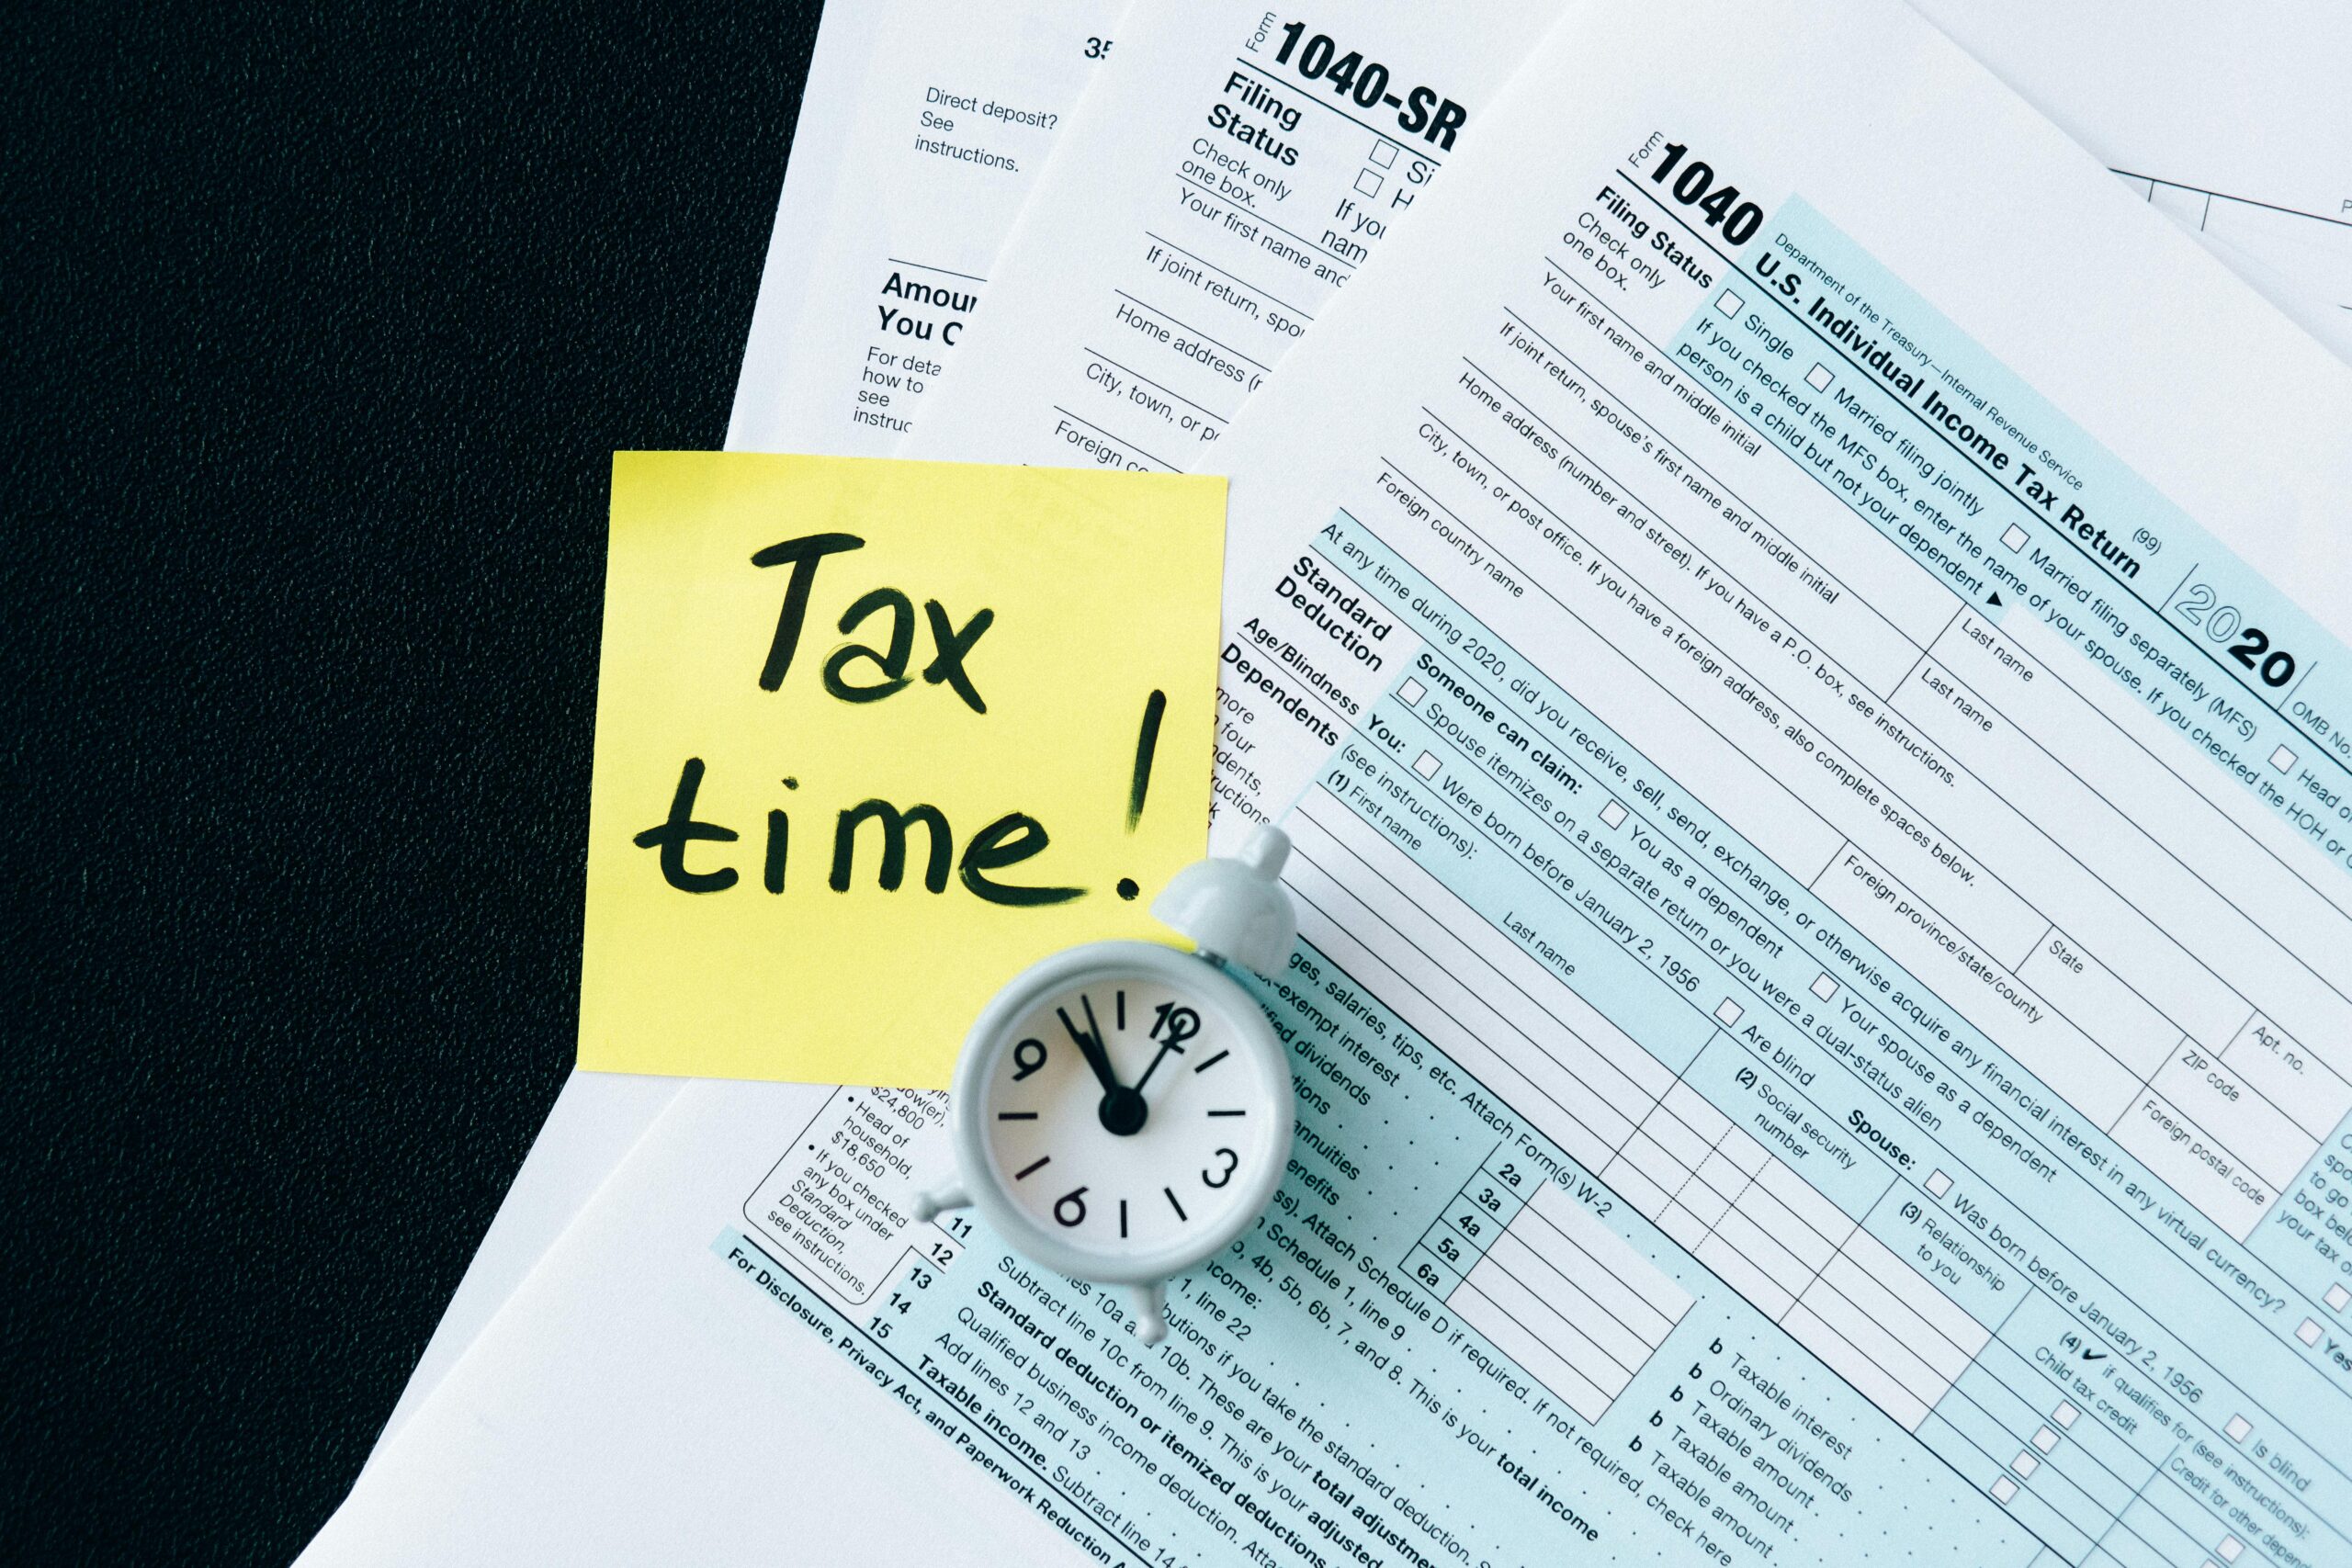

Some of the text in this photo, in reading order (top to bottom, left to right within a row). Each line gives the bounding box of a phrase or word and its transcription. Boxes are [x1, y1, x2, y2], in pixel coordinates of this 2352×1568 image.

[1245, 11, 1277, 53] Form
[925, 86, 1058, 130] Direct deposit?
[1223, 70, 1303, 132] Filing
[1275, 21, 1467, 152] 1040-SR
[921, 110, 955, 132] See
[1207, 103, 1299, 166] Status
[1627, 130, 1664, 169] Form
[914, 134, 1019, 173] instructions.
[1182, 160, 1255, 206] one box.
[1193, 138, 1293, 202] Check only
[1650, 142, 1764, 246] 1040
[1181, 186, 1311, 269] Your first name
[1577, 211, 1666, 289] Check only
[1595, 185, 1713, 288] Filing Status
[1146, 245, 1260, 321] If joint return,
[1563, 231, 1628, 291] one box.
[877, 305, 933, 341] You
[1115, 303, 1246, 383] Home address
[1744, 314, 1794, 360] Single
[862, 366, 924, 394] how to
[866, 345, 899, 367] For
[1543, 271, 1762, 457] Your first name and middle initial
[1774, 232, 1846, 296] Department
[1844, 292, 1862, 307] of
[1859, 302, 1880, 323] the
[1985, 406, 2038, 454] Revenue
[2038, 449, 2083, 491] Service
[857, 389, 890, 408] see
[1086, 363, 1202, 432] City, town, or
[1756, 251, 2141, 580] U.S. Individual Income Tax Return
[1055, 420, 1123, 468] Foreign
[1834, 387, 1984, 517] Married filing jointly
[1376, 471, 1524, 598] Foreign country name
[2132, 527, 2162, 557] (99)
[752, 533, 994, 714] Tax
[1274, 575, 1383, 672] Deduction
[1293, 556, 1393, 642] Standard
[1962, 617, 2033, 682] Last name
[2029, 547, 2257, 743] Married filing separately (MFS)
[2175, 583, 2296, 688] 2020
[1220, 642, 1339, 747] Dependents
[1242, 617, 1360, 716] Age/Blindness
[1368, 713, 1406, 754] You:
[1416, 653, 1583, 795] Someone can claim:
[633, 689, 1166, 906] time!
[1327, 769, 1422, 851] (1) First name
[1340, 743, 1477, 860] (see instructions):
[1502, 910, 1576, 976] Last name
[1844, 854, 2044, 1024] Foreign province/state/county
[2049, 940, 2084, 974] State
[1148, 1001, 1201, 1055] 12
[1741, 1024, 1816, 1087] Are blind
[2251, 1026, 2303, 1075] Apt. no.
[1012, 1038, 1047, 1082] 9
[2181, 1049, 2240, 1102] ZIP code
[854, 1100, 910, 1148] Head of
[870, 1086, 925, 1130] $24,800
[1735, 1066, 1857, 1170] (2) Social security
[1754, 1112, 1810, 1159] number
[831, 1131, 886, 1179] $18,650
[842, 1115, 912, 1180] household,
[1203, 1148, 1238, 1188] 3
[1848, 1109, 1917, 1170] Spouse:
[2142, 1099, 2266, 1206] Foreign postal code
[791, 1179, 854, 1231] Standard
[803, 1167, 894, 1241] any box under
[815, 1148, 910, 1229] If you checked
[1478, 1188, 1501, 1213] 3a
[1498, 1163, 1522, 1188] 2a
[778, 1193, 845, 1255] Deduction,
[951, 1217, 973, 1239] 11
[1054, 1187, 1088, 1227] 6
[1458, 1214, 1481, 1238] 4a
[767, 1210, 865, 1296] see instructions.
[931, 1243, 954, 1266] 12
[1417, 1263, 1440, 1288] 6a
[1437, 1237, 1460, 1263] 5a
[1899, 1201, 2006, 1292] (3) Relationship
[1917, 1243, 1962, 1285] to you
[889, 1292, 912, 1315] 14
[910, 1267, 933, 1290] 13
[869, 1316, 893, 1339] 15
[1708, 1337, 1724, 1355] b
[2324, 1337, 2352, 1372] Yes
[728, 1247, 1112, 1565] For Disclosure, Privacy Act, and Paperwork Reduction
[1731, 1352, 1852, 1461] Taxable interest
[2251, 1438, 2312, 1493] Is blind
